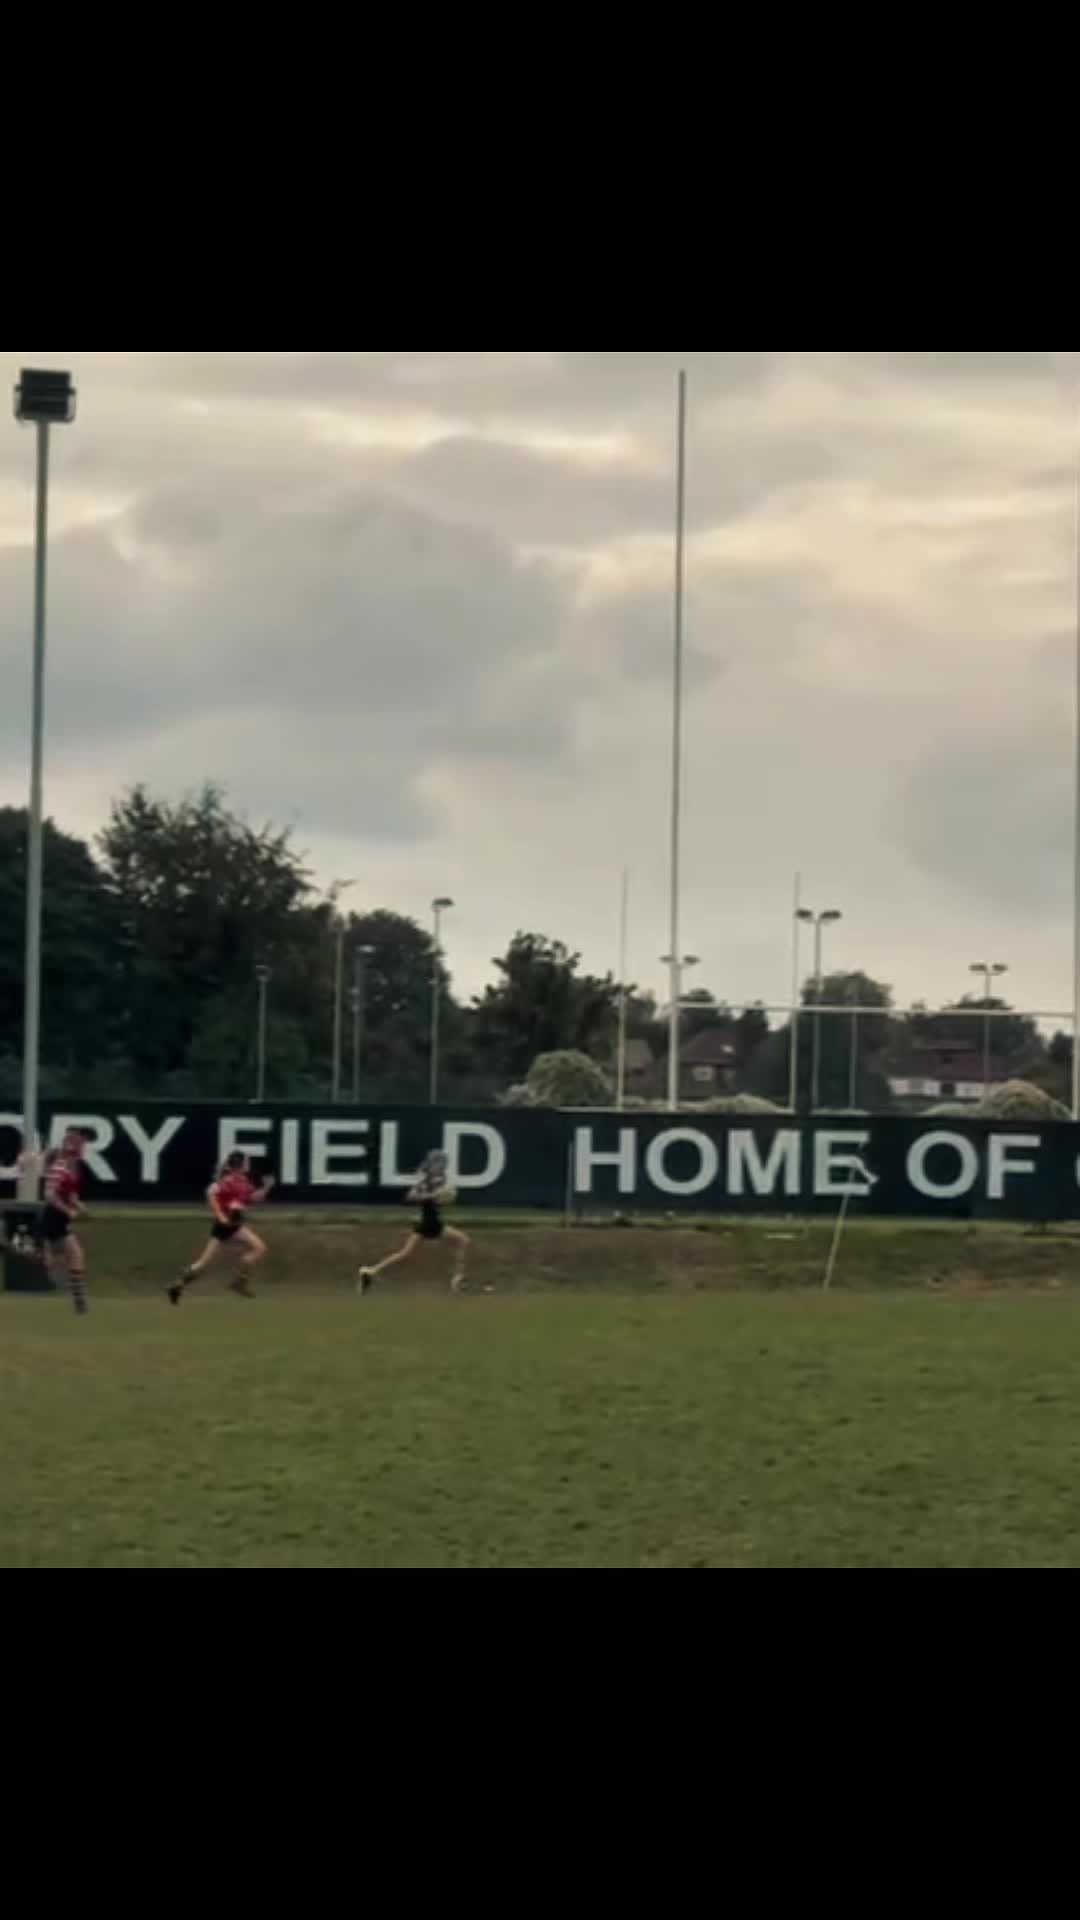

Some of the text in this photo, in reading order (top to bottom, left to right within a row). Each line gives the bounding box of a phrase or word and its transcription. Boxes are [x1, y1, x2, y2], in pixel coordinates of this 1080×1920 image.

[216, 1116, 507, 1188] FIELD
[574, 1126, 871, 1195] HOME
[906, 1129, 1041, 1199] OF
